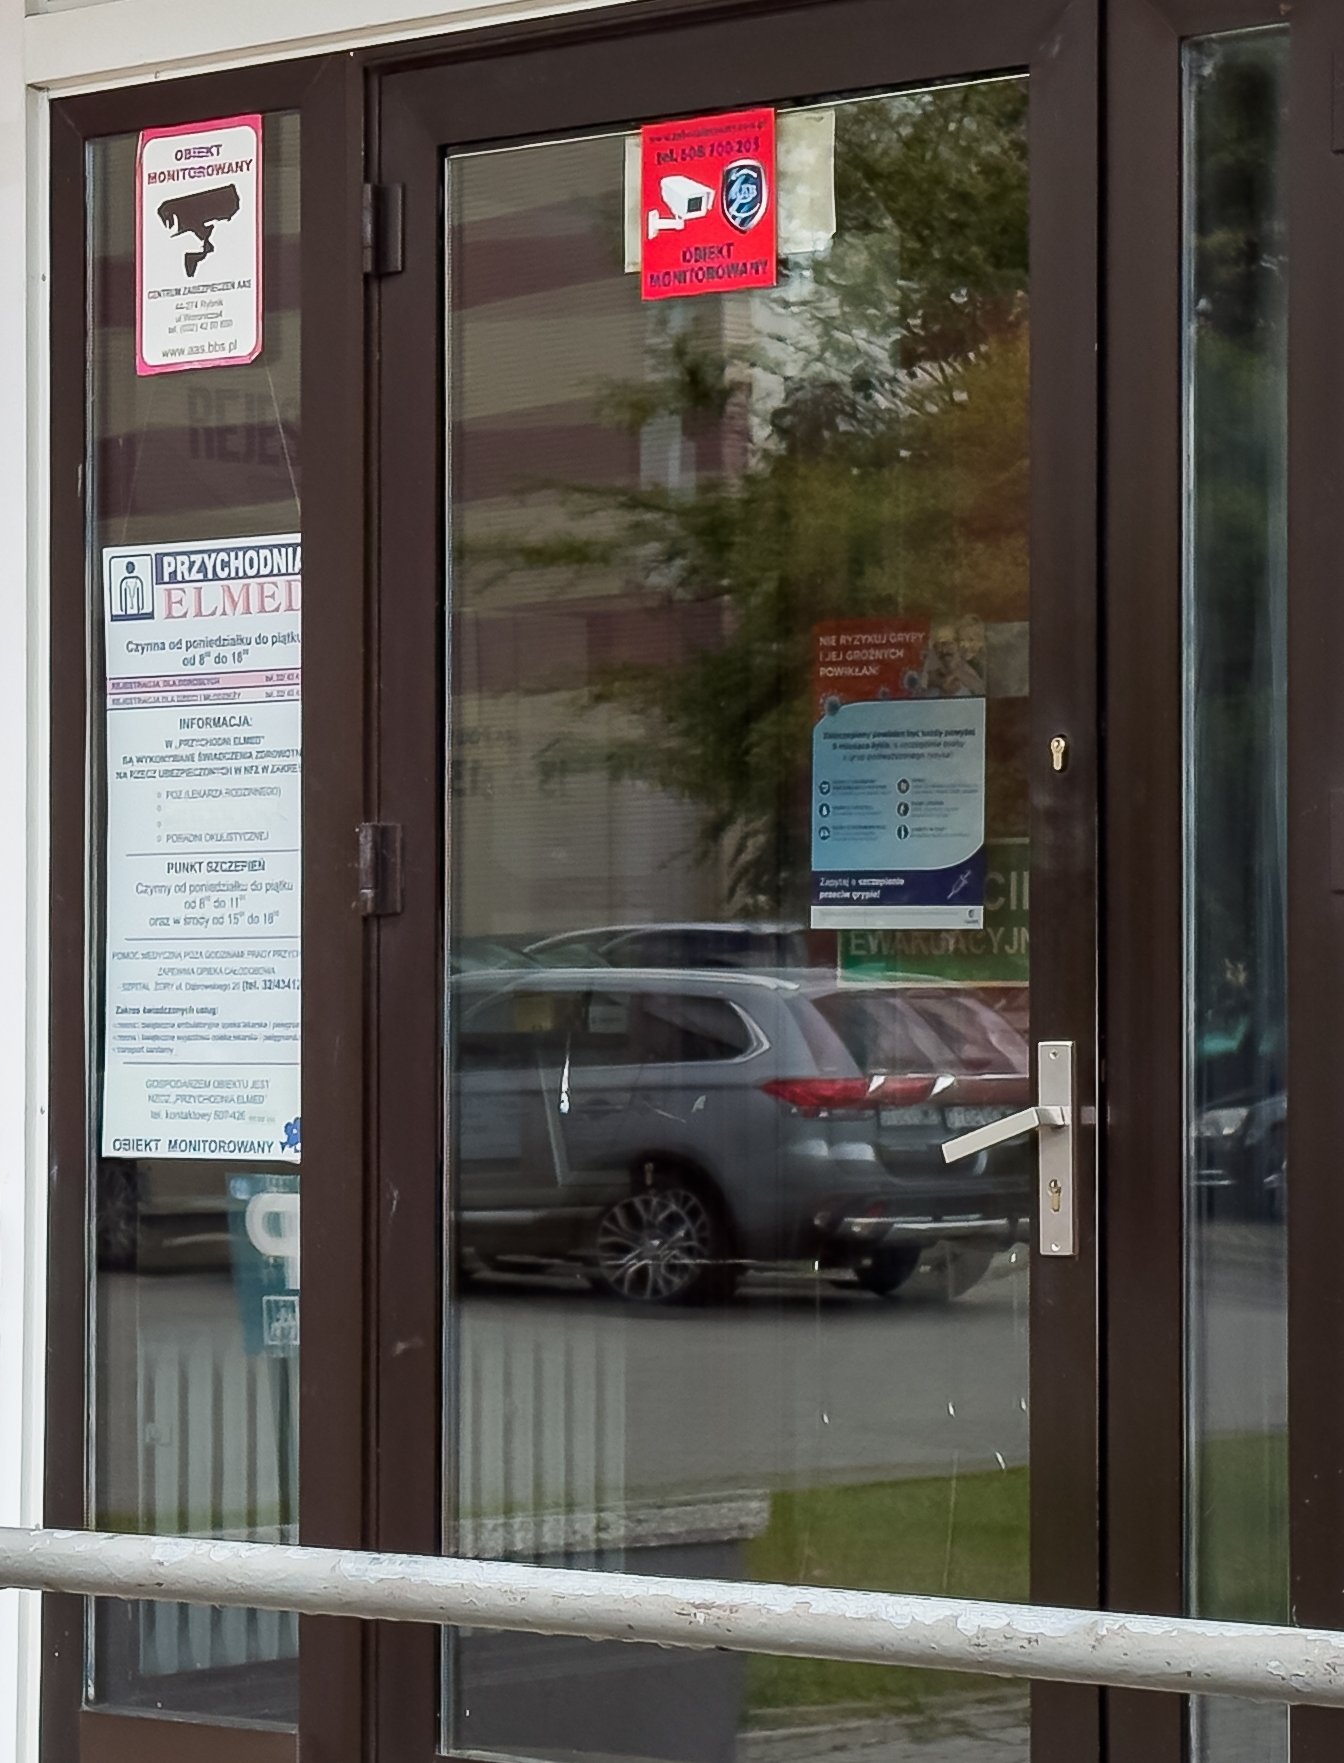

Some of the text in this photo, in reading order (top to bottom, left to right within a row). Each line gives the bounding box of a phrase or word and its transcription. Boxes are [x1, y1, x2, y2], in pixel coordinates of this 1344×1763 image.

[175, 144, 222, 161] OBIEKT
[148, 159, 253, 184] MONITOROWANY
[682, 243, 735, 264] OBIEKT
[650, 260, 768, 288] MONITOROWANY
[164, 579, 301, 620] ELMED
[126, 640, 165, 654] Czynna
[169, 638, 182, 650] od
[256, 632, 268, 645] do
[214, 651, 227, 664] do
[167, 861, 204, 874] PUNKT
[112, 1139, 274, 1154] OBIEKT MONITOROWANY
